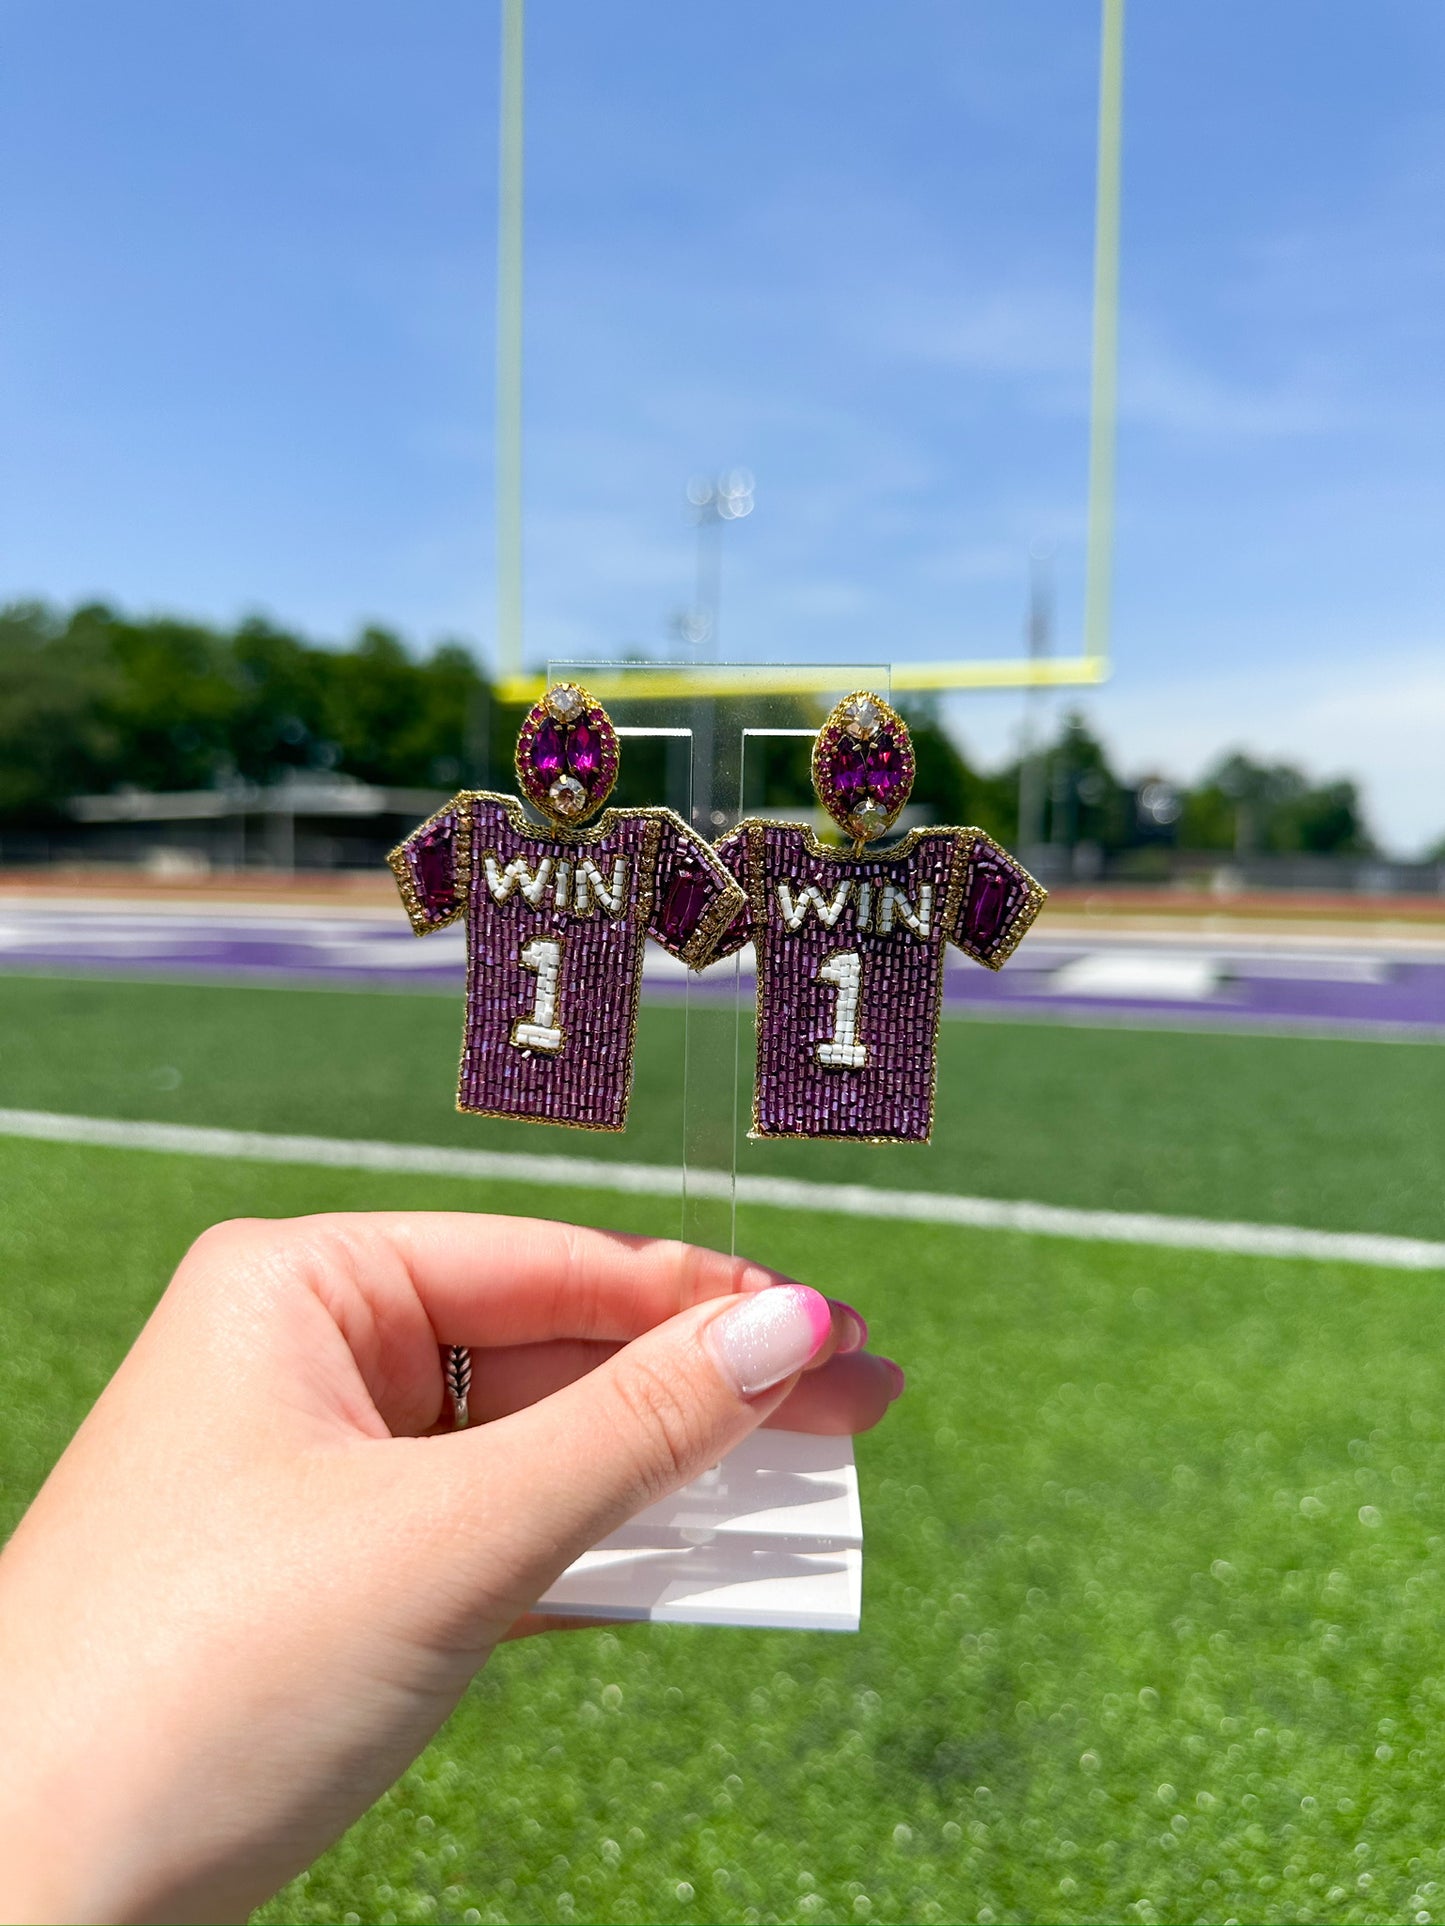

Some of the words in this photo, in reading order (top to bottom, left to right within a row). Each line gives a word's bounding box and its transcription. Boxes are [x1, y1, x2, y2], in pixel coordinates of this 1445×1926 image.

[484, 856, 627, 912] WIN
[778, 880, 931, 937] WIN
[515, 940, 562, 1048] 1
[817, 952, 867, 1067] 1
